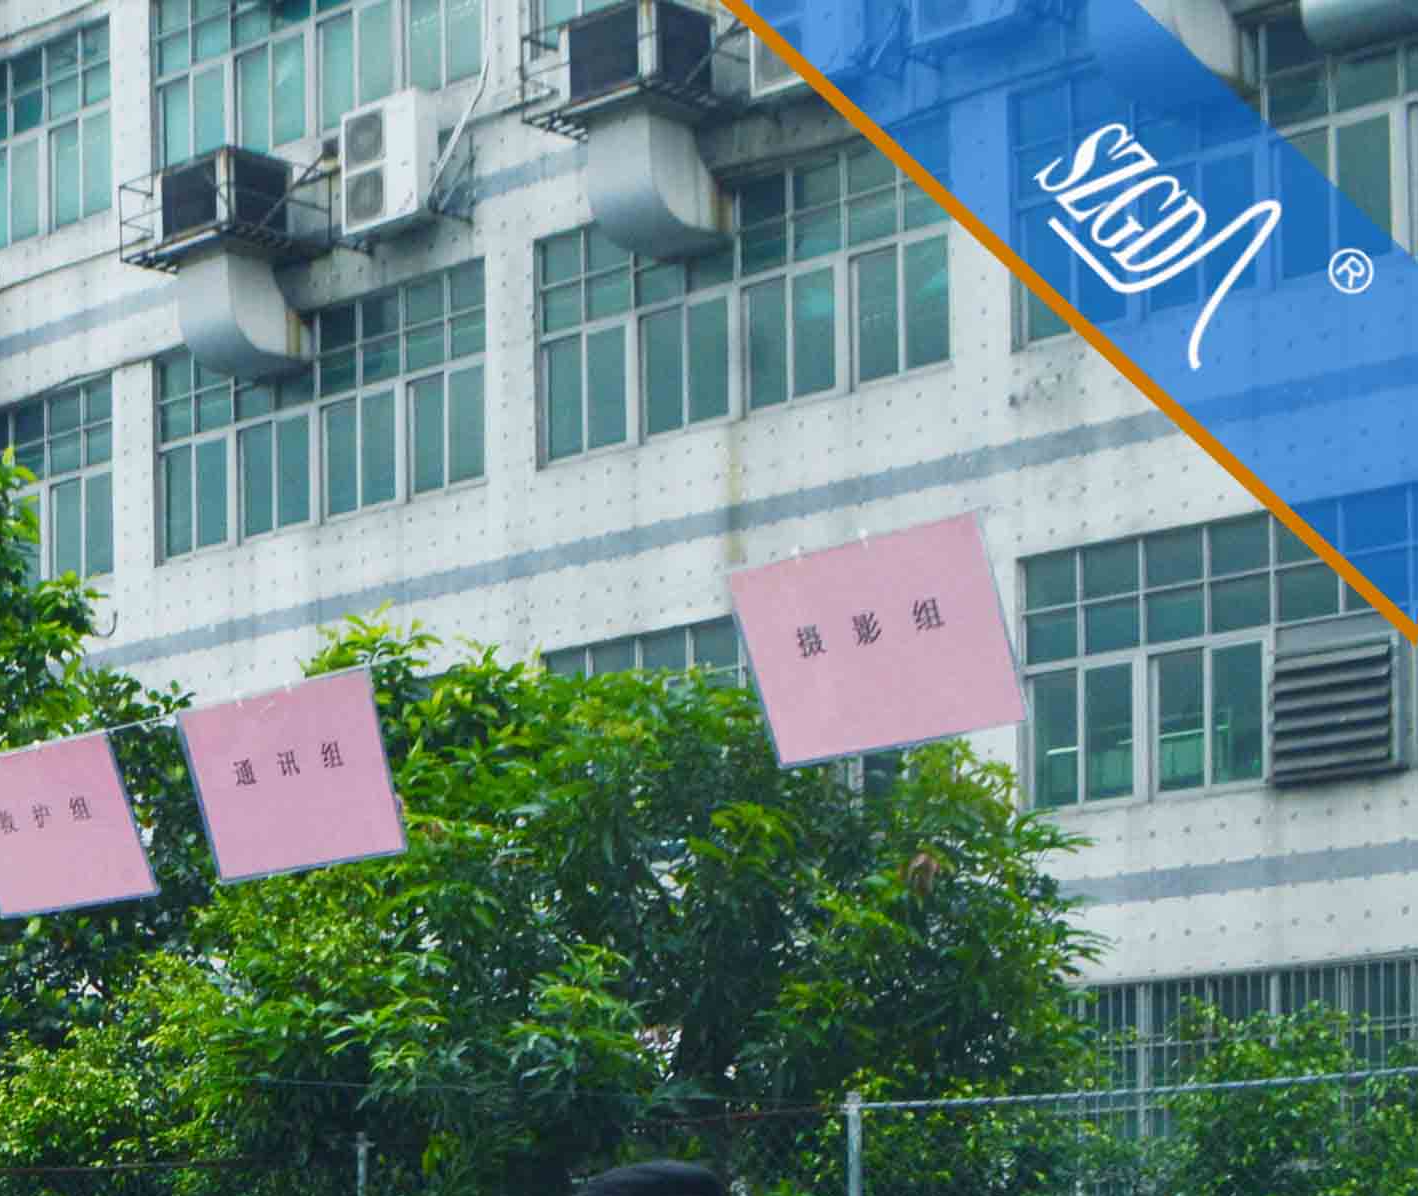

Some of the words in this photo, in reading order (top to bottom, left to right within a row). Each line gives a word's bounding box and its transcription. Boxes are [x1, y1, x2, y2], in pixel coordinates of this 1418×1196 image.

[796, 597, 946, 660] 摄影组
[232, 740, 345, 786] 通讯组
